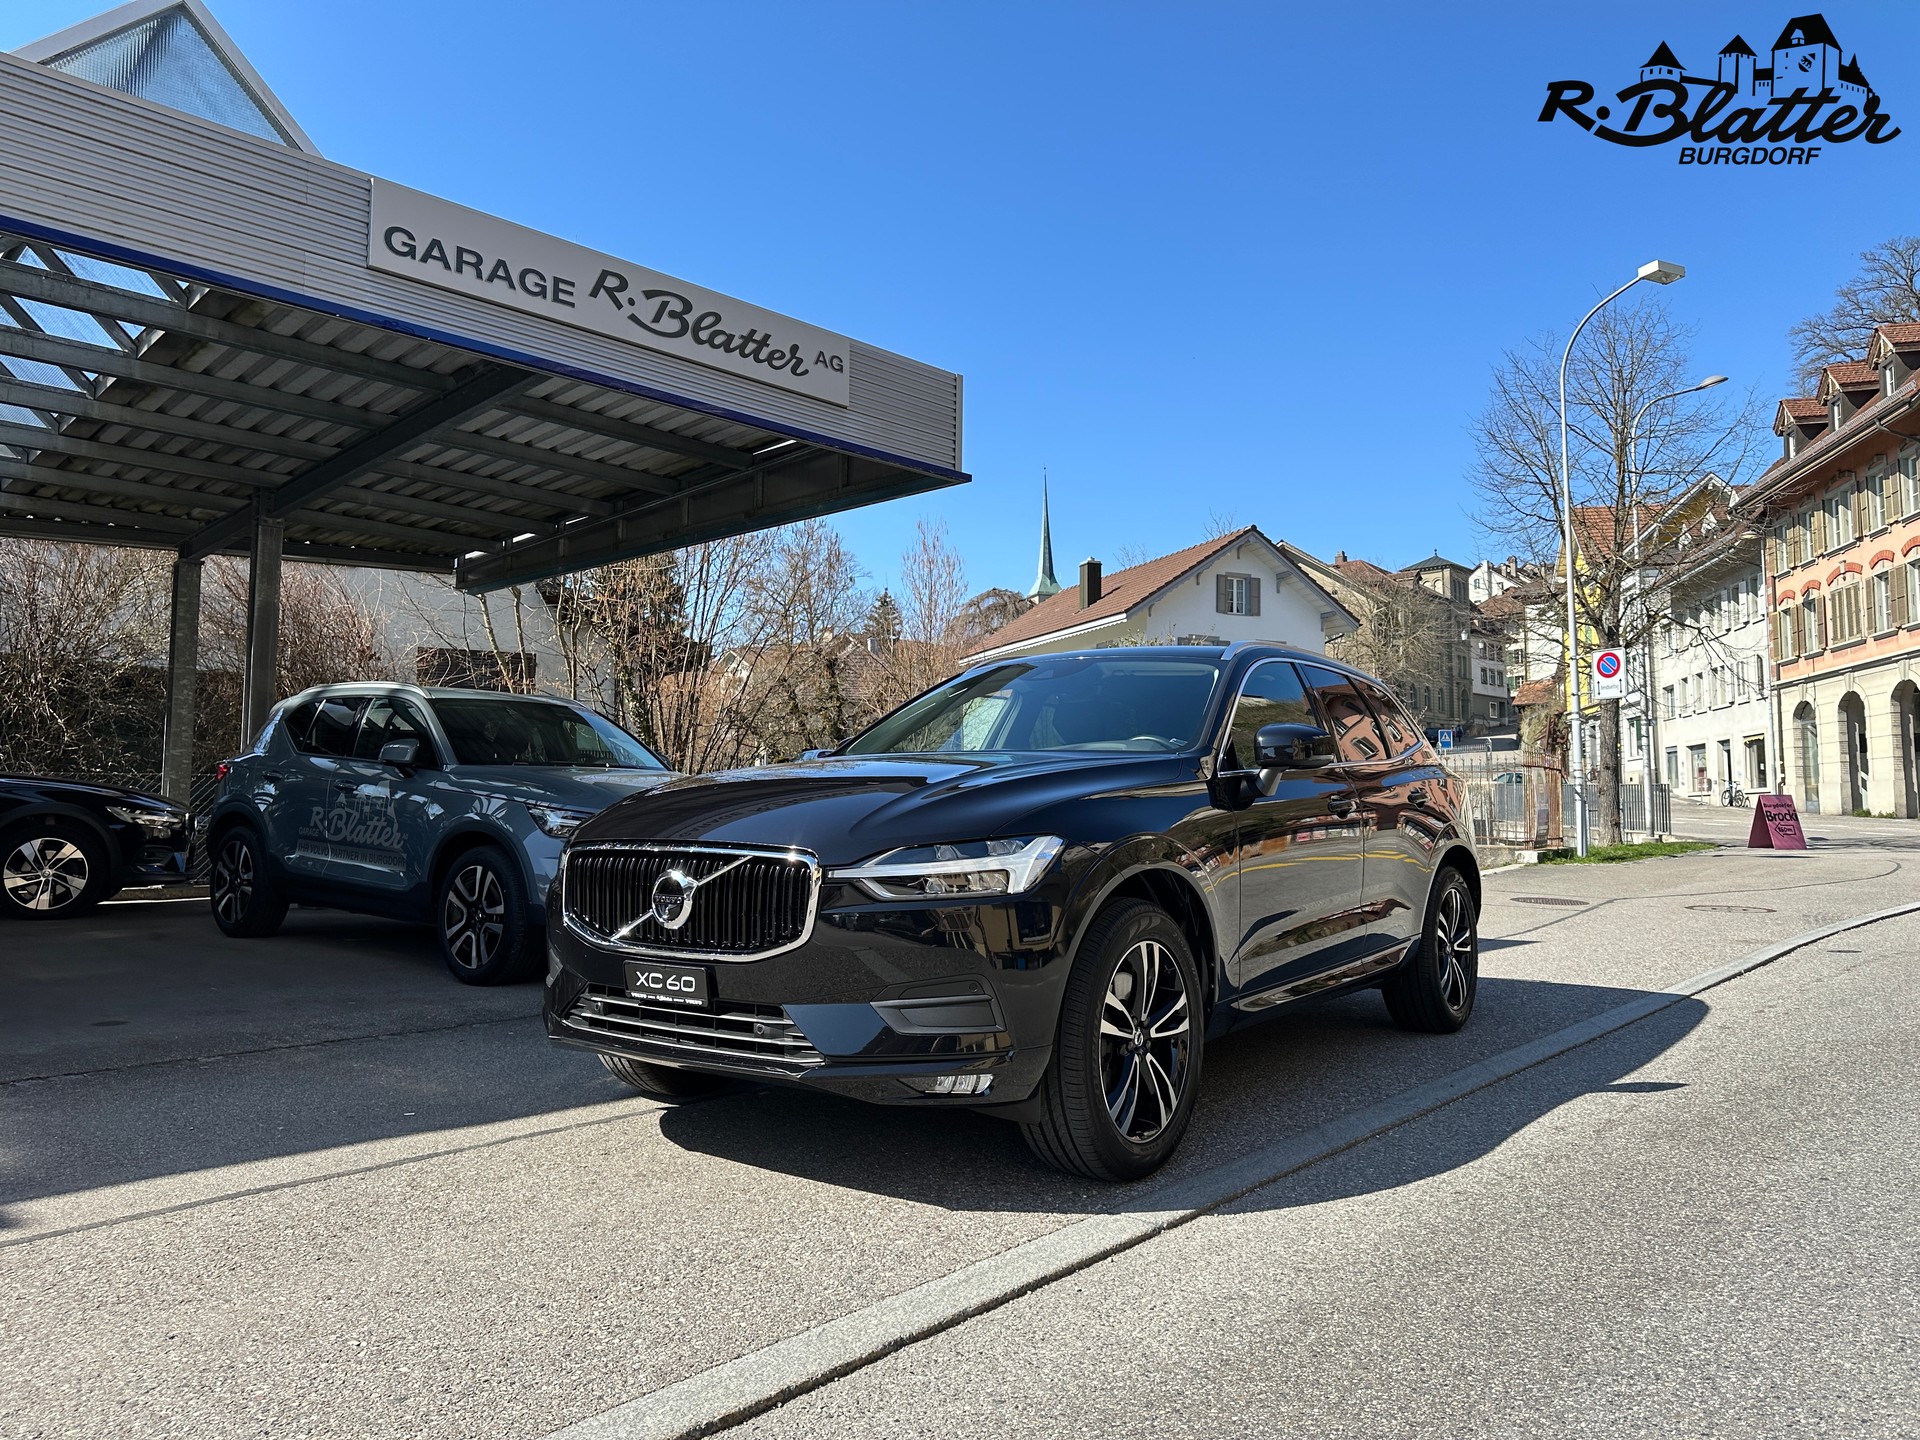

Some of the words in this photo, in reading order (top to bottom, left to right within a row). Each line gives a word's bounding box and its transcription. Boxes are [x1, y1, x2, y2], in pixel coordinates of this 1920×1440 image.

[384, 226, 575, 308] GARAGE
[814, 349, 844, 374] AG
[1765, 809, 1800, 822] Brocki
[298, 826, 320, 837] GARAGE
[331, 846, 361, 861] PARTNER
[368, 853, 407, 867] BURGDORF
[636, 971, 663, 988] XC
[666, 975, 696, 992] 60
